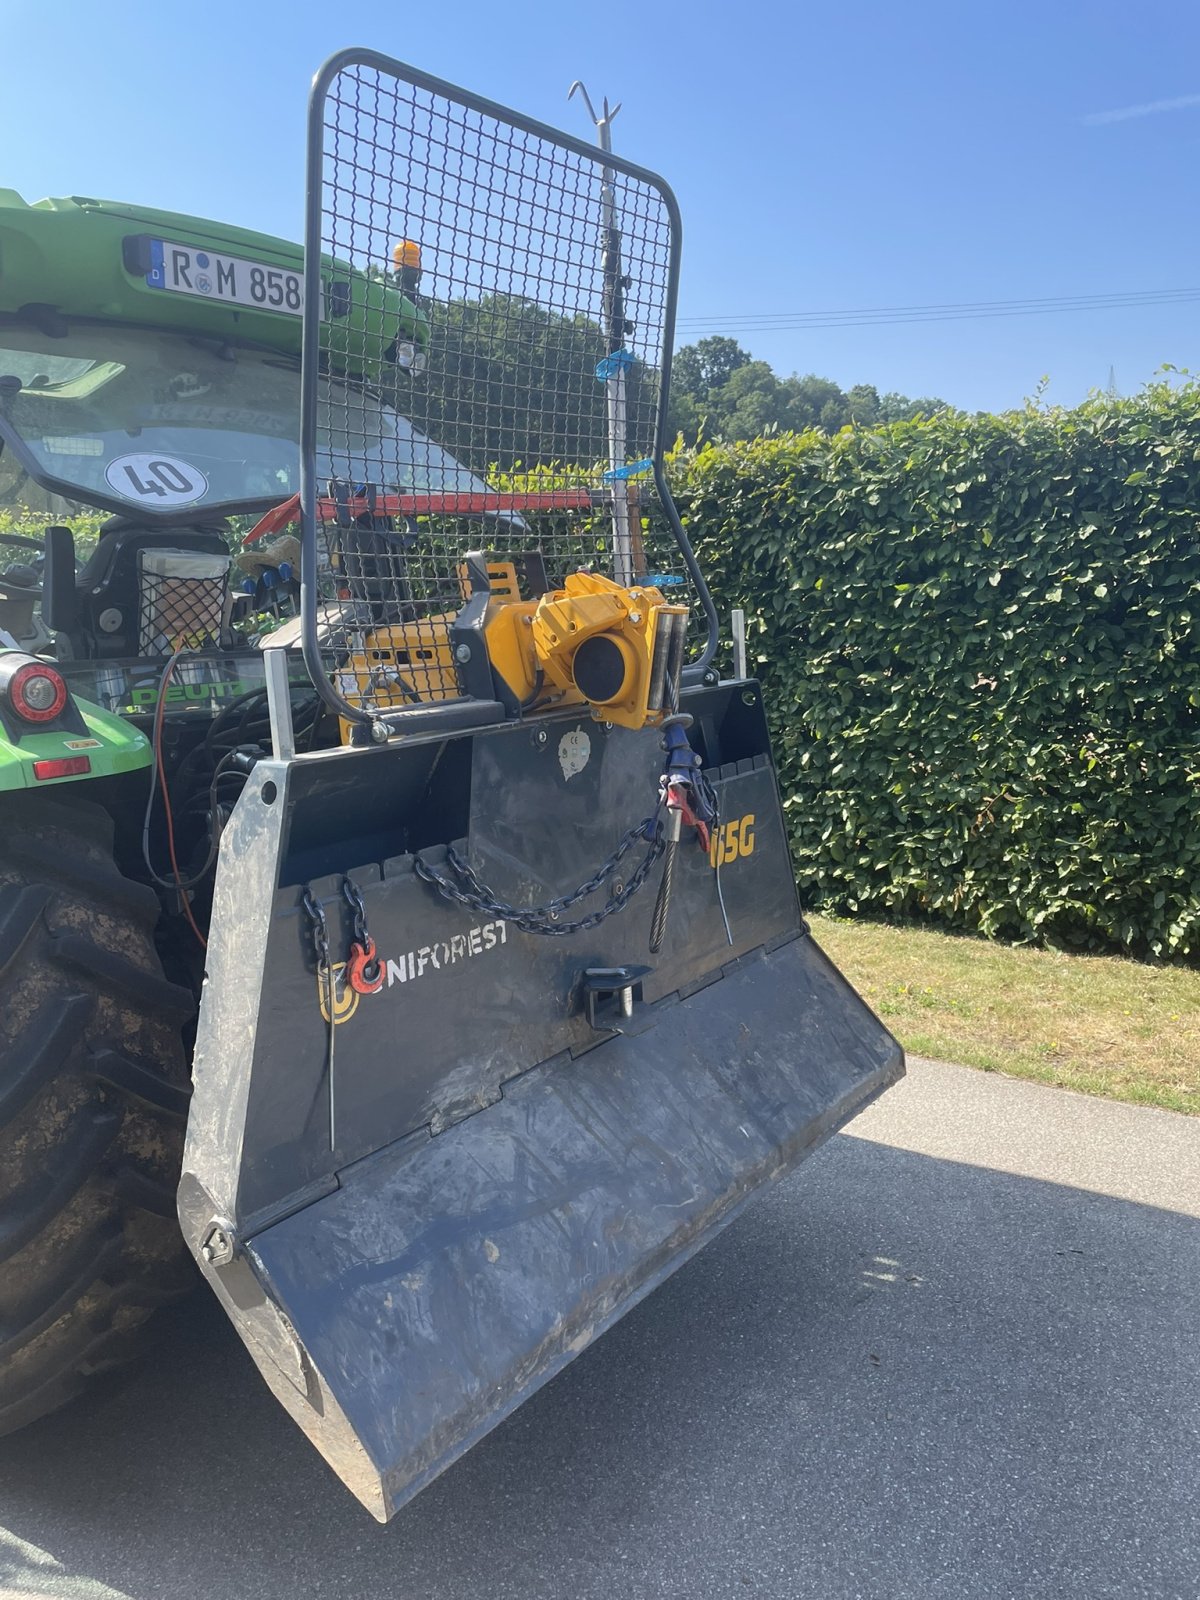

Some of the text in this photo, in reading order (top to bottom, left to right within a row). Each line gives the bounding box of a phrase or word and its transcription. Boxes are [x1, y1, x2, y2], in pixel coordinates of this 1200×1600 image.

[152, 269, 159, 280] D
[172, 249, 305, 310] R M 858
[123, 461, 193, 497] 40
[570, 736, 578, 745] CE
[371, 920, 507, 994] NIFOREST
